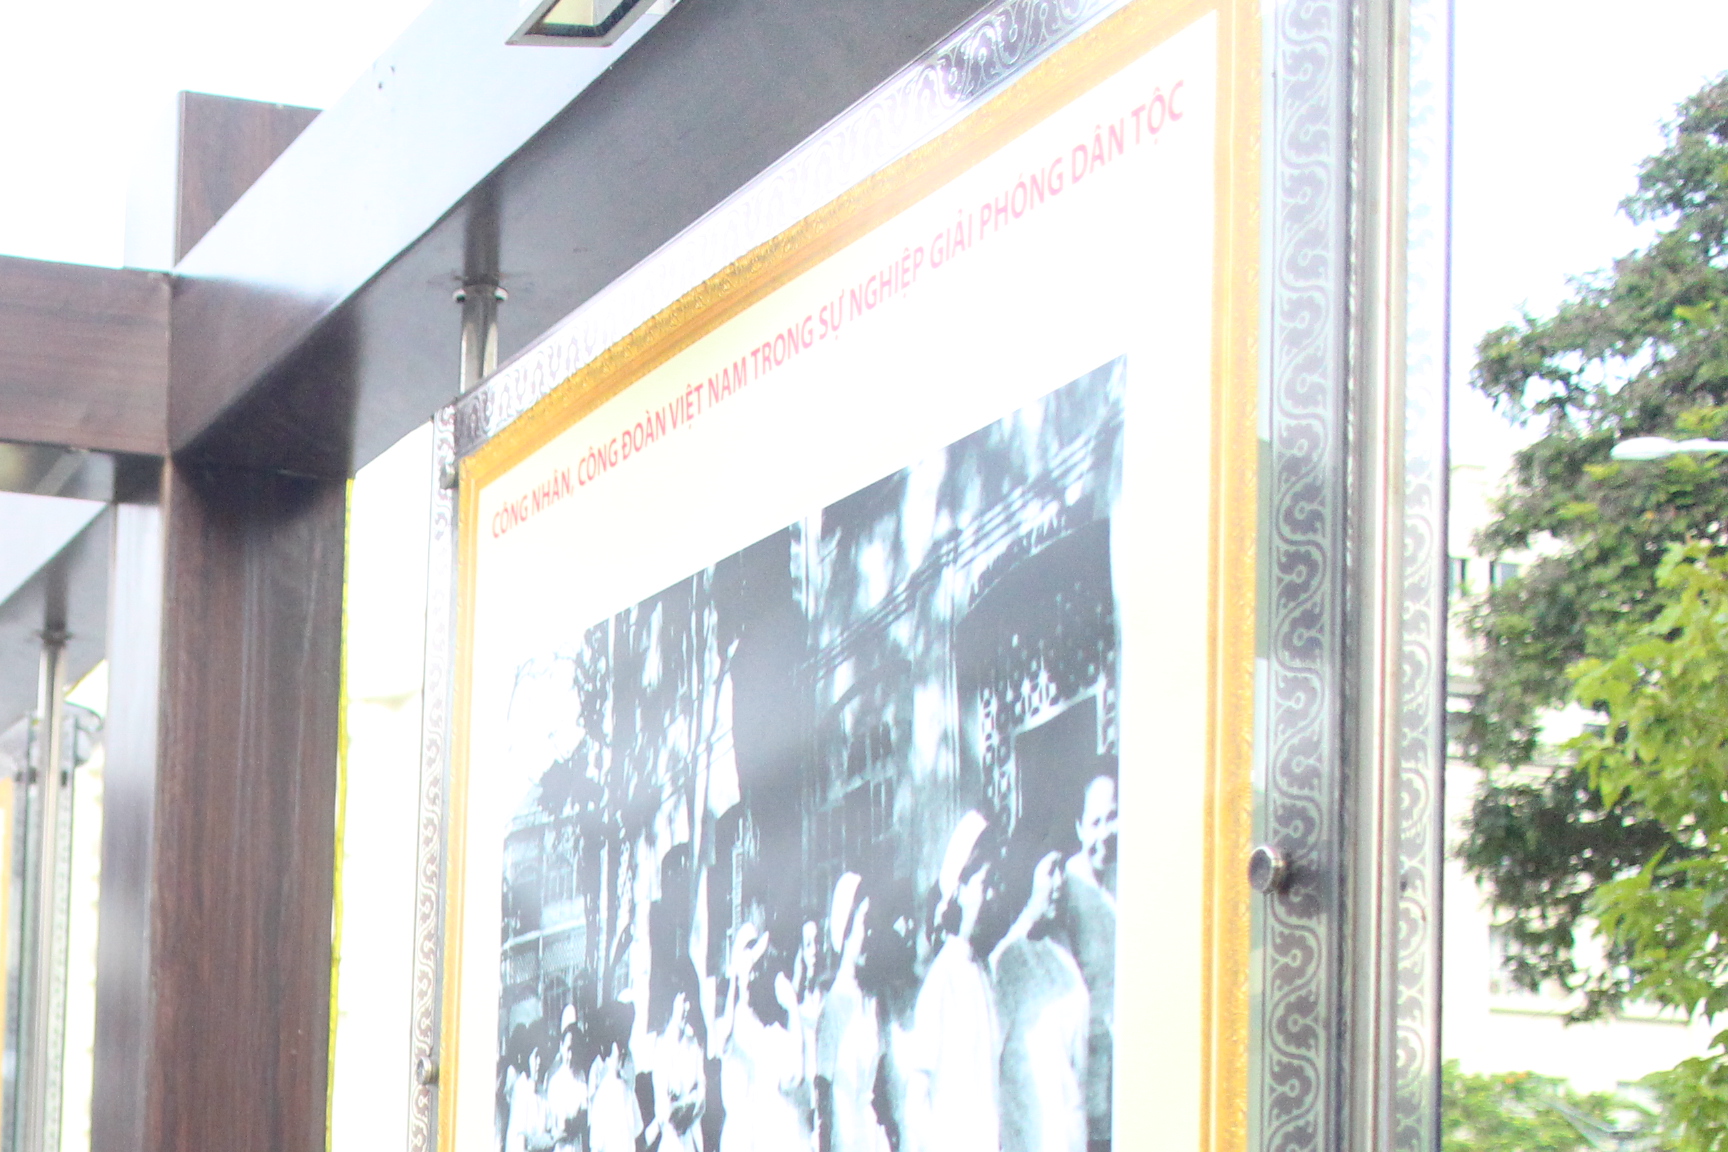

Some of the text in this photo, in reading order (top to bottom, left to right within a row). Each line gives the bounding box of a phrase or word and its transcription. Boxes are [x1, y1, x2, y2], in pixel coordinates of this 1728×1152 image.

[492, 79, 1184, 539] CÔNG NHÂN, CÔNG ĐOÀN VIỆT NAM TRONG SỰ NGHIỆP GIẢI PHÓNG DÂN TỘC
